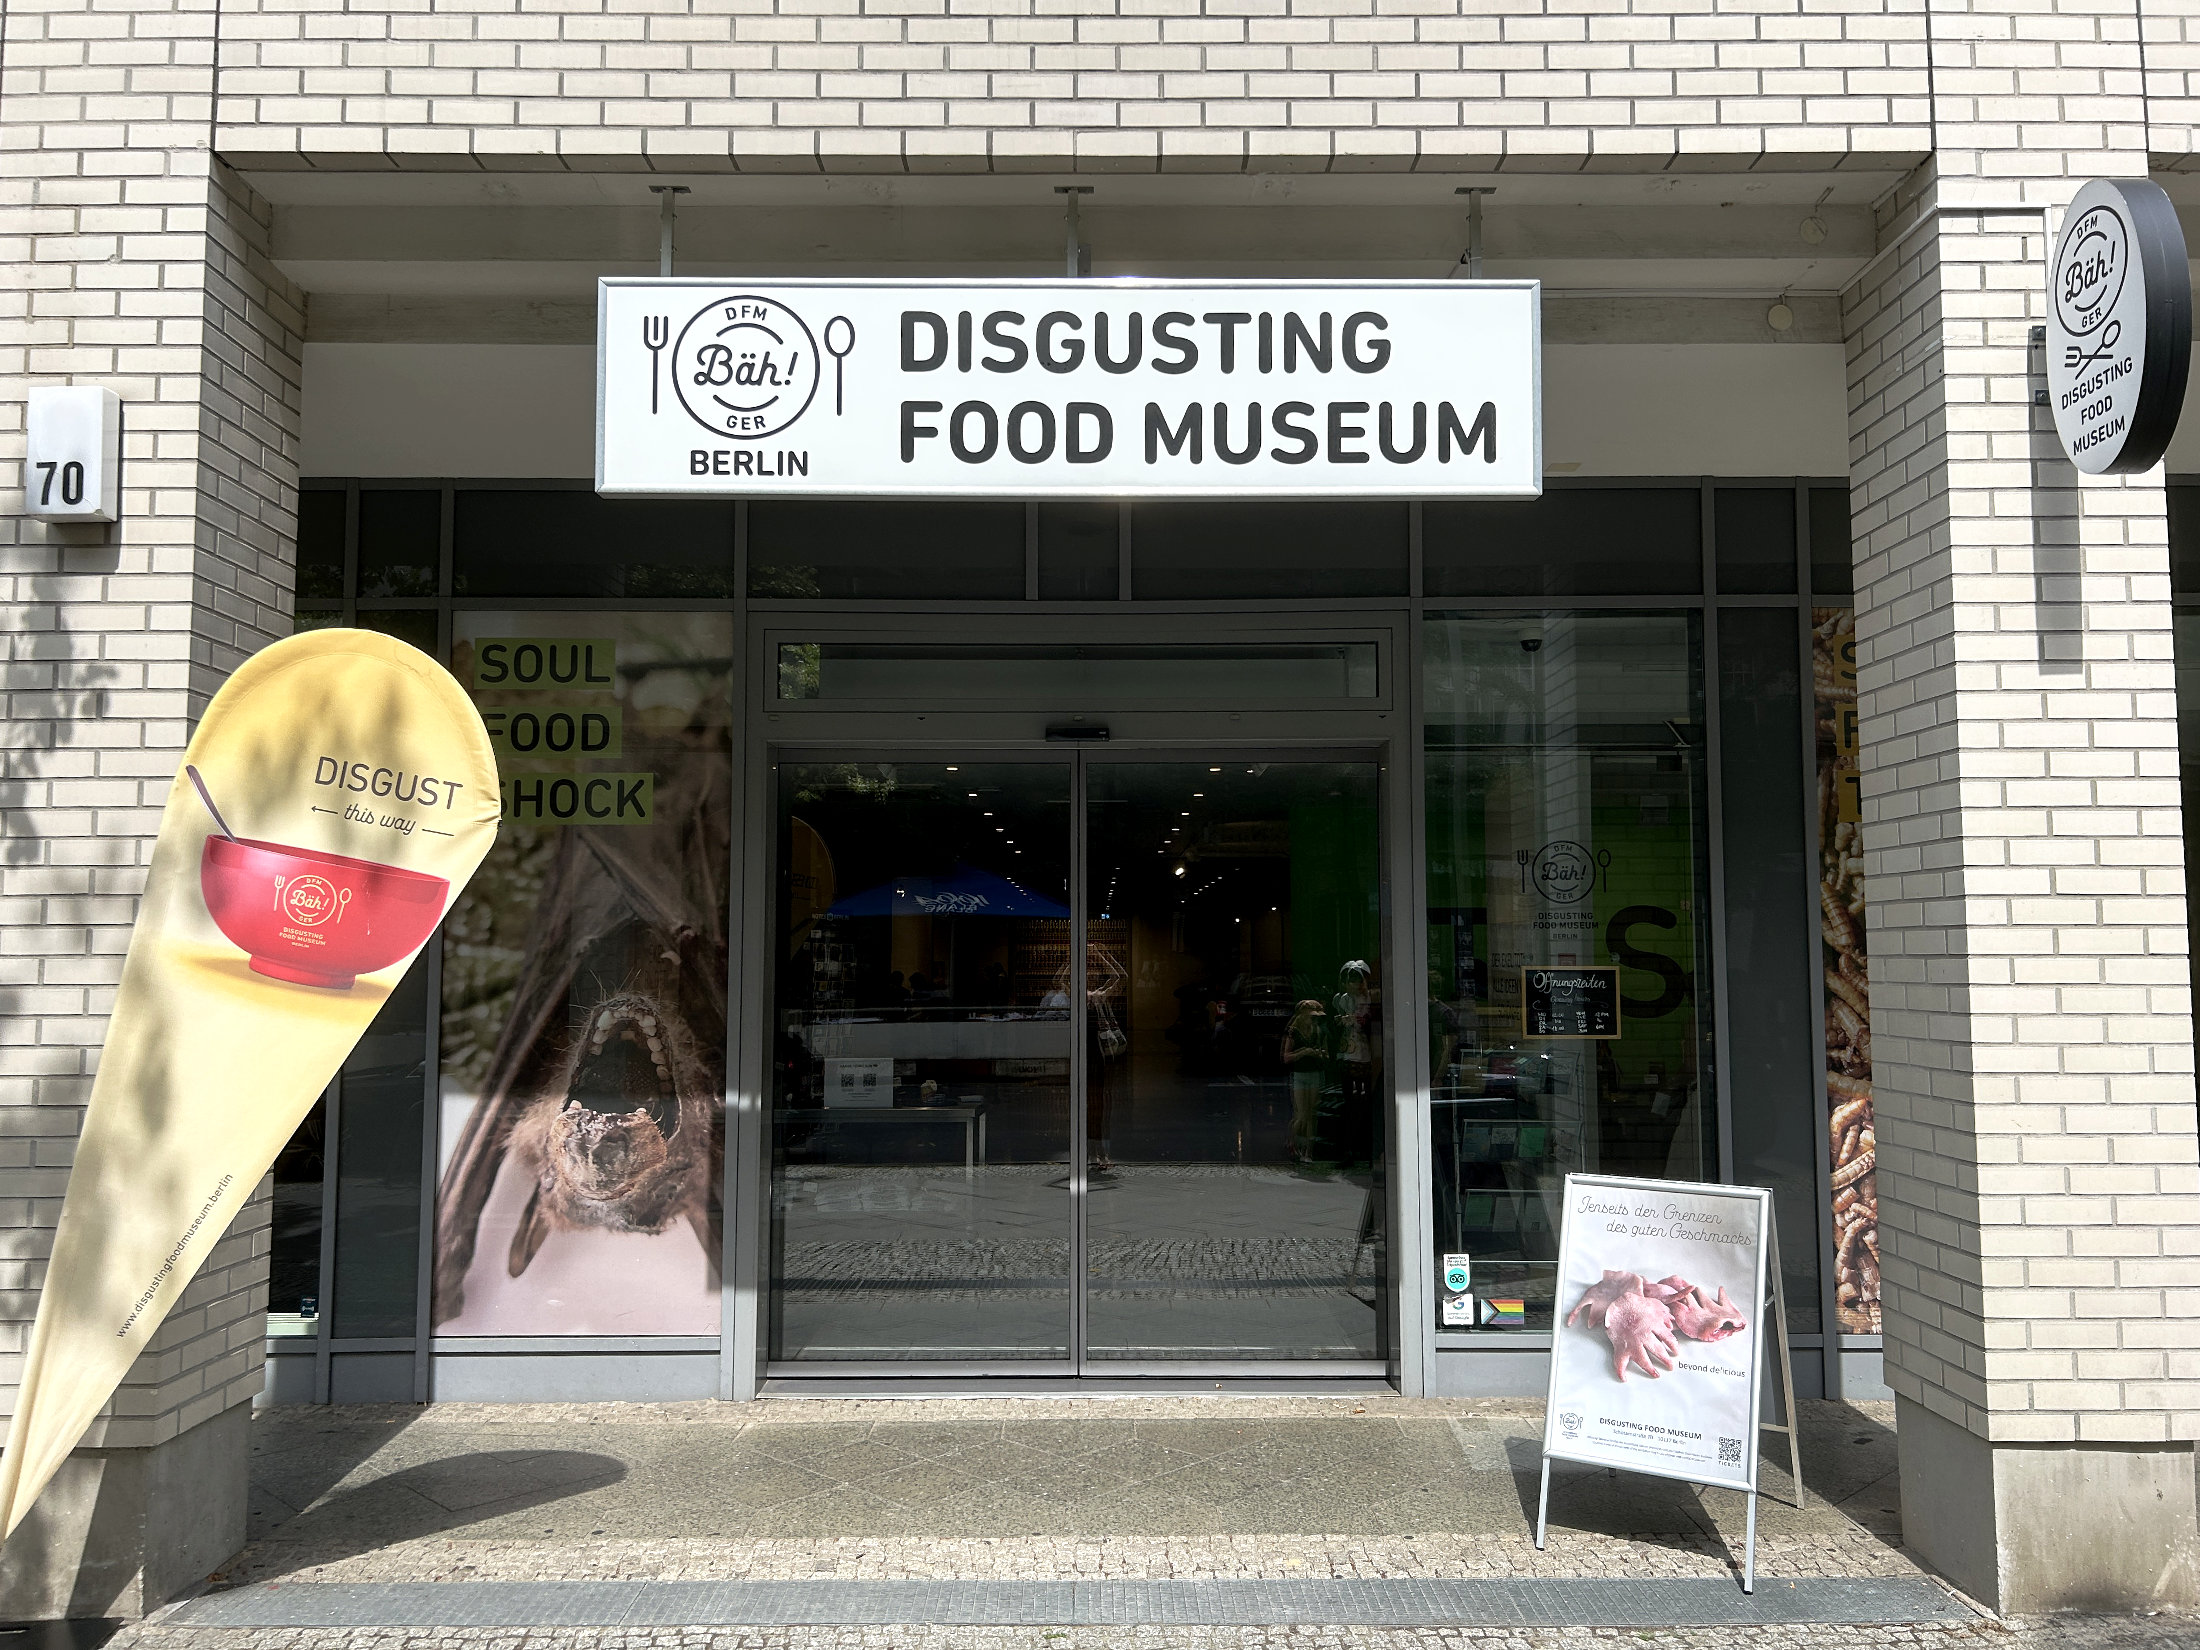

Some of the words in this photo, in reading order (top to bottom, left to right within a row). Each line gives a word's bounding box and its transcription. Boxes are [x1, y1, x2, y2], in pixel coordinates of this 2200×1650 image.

[2076, 214, 2098, 239] DFM
[2065, 240, 2116, 304] Bäh!
[725, 305, 767, 321] DFM
[2081, 307, 2103, 328] GER
[901, 310, 1391, 375] DISGUSTING
[694, 343, 798, 386] Bäh!
[2061, 356, 2134, 410] DISGUSTING
[726, 415, 766, 430] GER
[2080, 395, 2113, 426] FOOD
[900, 400, 1114, 465] FOOD
[1144, 400, 1497, 466] MUSEUM
[2072, 415, 2126, 456] MUSEUM
[690, 449, 808, 476] BERLIN
[36, 461, 84, 506] 70
[480, 644, 611, 683] SOUL
[315, 756, 464, 810] DISGUST
[501, 779, 646, 818] HOCK
[344, 803, 375, 824] this
[379, 814, 417, 835] way
[1541, 862, 1587, 880] Bäh!
[290, 889, 330, 910] Bäh!
[1533, 921, 1557, 929] FOOD
[1559, 921, 1599, 929] MUSEUM
[1538, 912, 1593, 920] DISGUSTING
[279, 932, 296, 940] FOOD
[297, 936, 326, 946] MUSEUM
[283, 927, 324, 940] DISGUSTING
[1533, 970, 1608, 996] Öffnungszeiten
[1577, 1195, 1629, 1216] Jenseits
[1634, 1204, 1660, 1219] der
[1663, 1203, 1723, 1225] Grenzen
[1606, 1219, 1628, 1234] des
[1631, 1224, 1668, 1238] guten
[1669, 1222, 1752, 1246] Geschmacks
[116, 1173, 234, 1338] www.disgustingfoodmuseum.berlin
[1678, 1360, 1708, 1374] beyond
[1709, 1365, 1746, 1378] delicious
[1600, 1417, 1643, 1431] DISGUSTING
[1644, 1425, 1666, 1434] FOOD
[1667, 1428, 1702, 1441] MUSEUM
